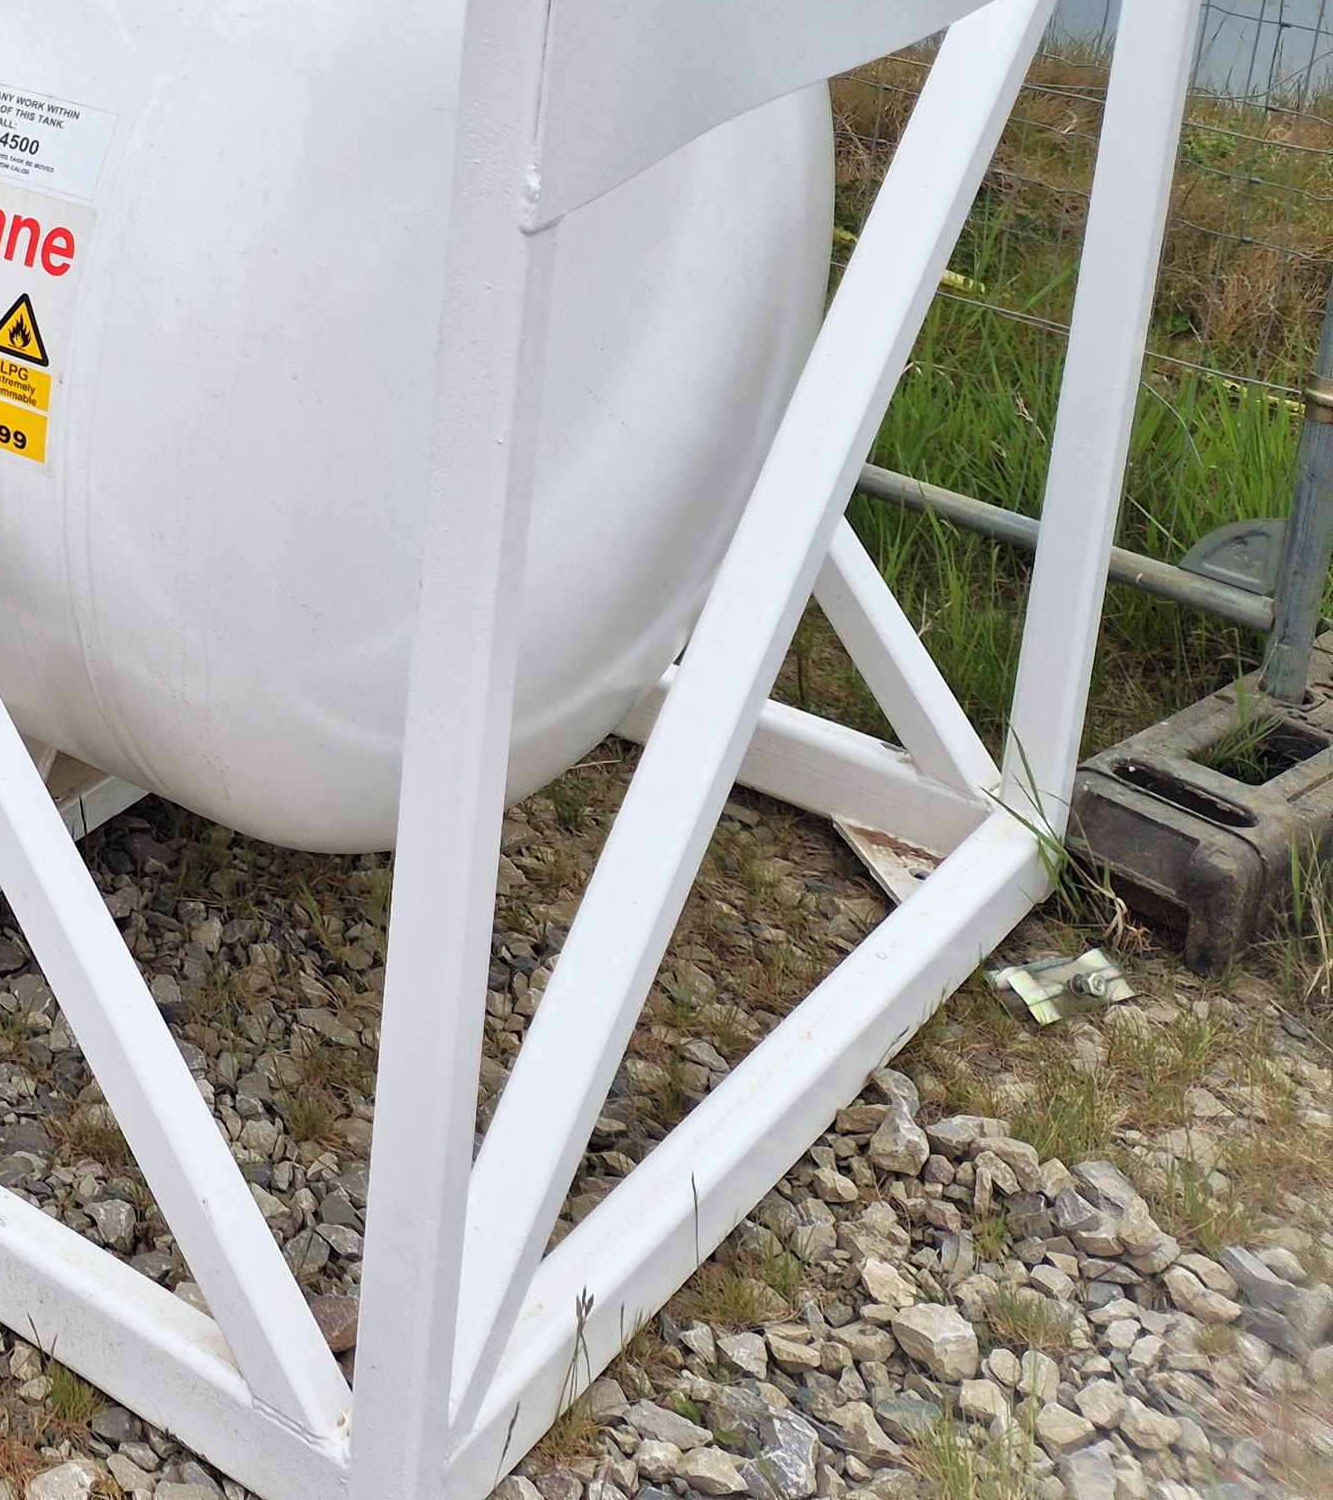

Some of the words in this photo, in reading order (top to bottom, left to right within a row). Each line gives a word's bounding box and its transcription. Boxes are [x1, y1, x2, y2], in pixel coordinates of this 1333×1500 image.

[0, 104, 13, 114] OF
[15, 108, 35, 121] THIS
[38, 114, 65, 129] TANK.
[16, 96, 45, 111] WORK
[47, 104, 80, 120] WITHIN
[0, 131, 39, 155] 4500
[0, 361, 29, 381] LPG
